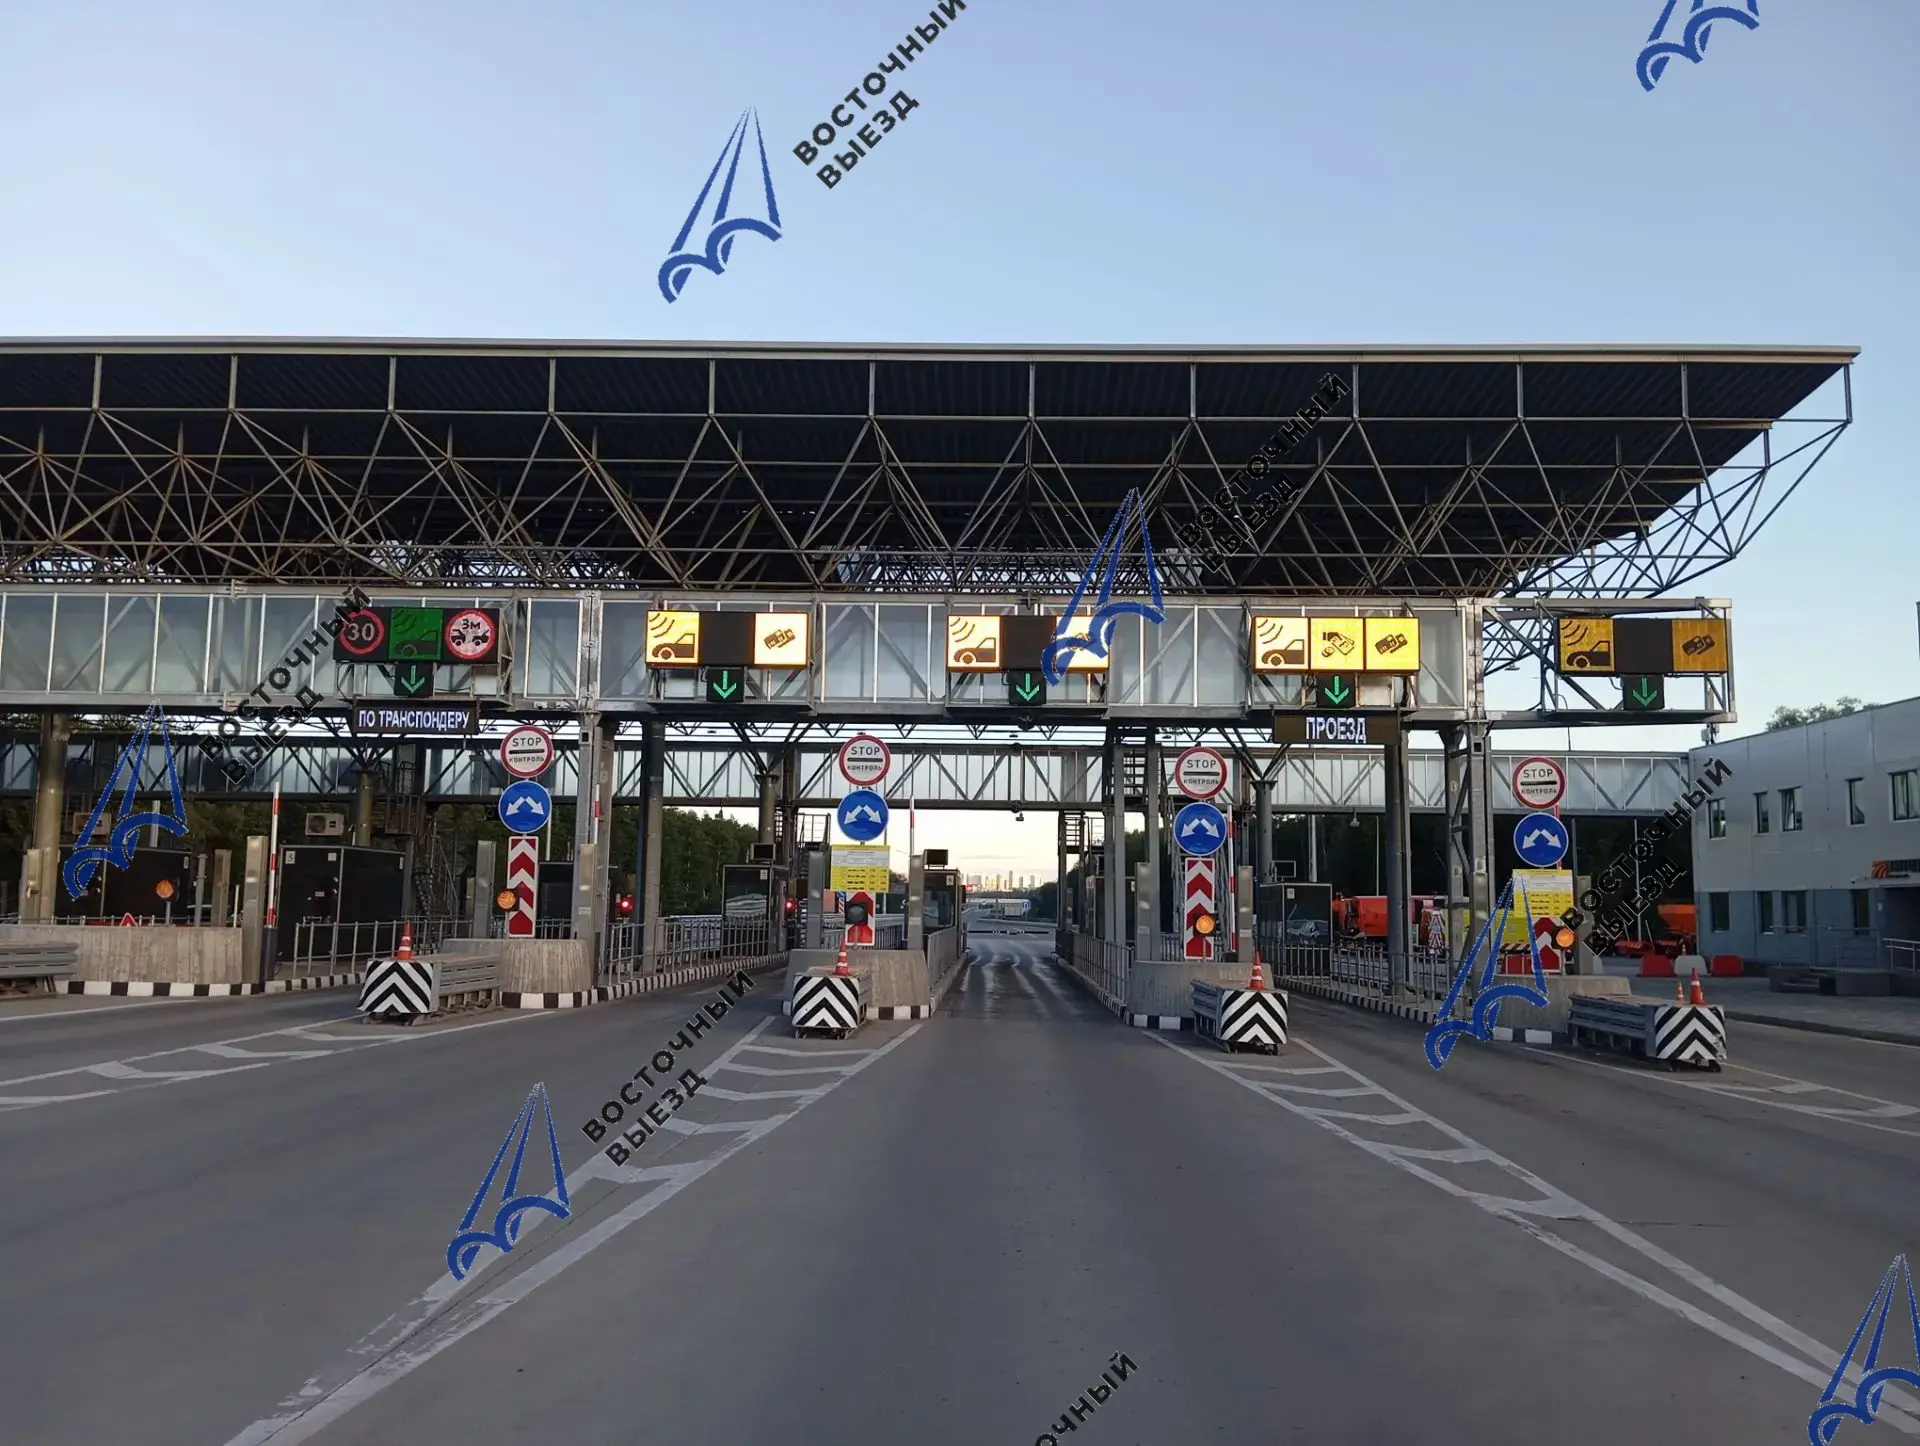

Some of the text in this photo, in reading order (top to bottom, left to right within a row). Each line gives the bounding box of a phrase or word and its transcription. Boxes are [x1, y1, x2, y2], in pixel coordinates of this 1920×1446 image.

[348, 622, 375, 641] 30
[359, 710, 470, 731] ПО ТРАНСПОНДЕРУ
[1305, 716, 1367, 743] ПРОЕЗД
[512, 737, 542, 747] STOP
[851, 746, 881, 755] STOP
[509, 756, 545, 764] КОНТРОЛЬ
[1186, 759, 1217, 769] STOP
[847, 763, 882, 772] КОНТРОЛЬ
[1523, 769, 1554, 779] STOP
